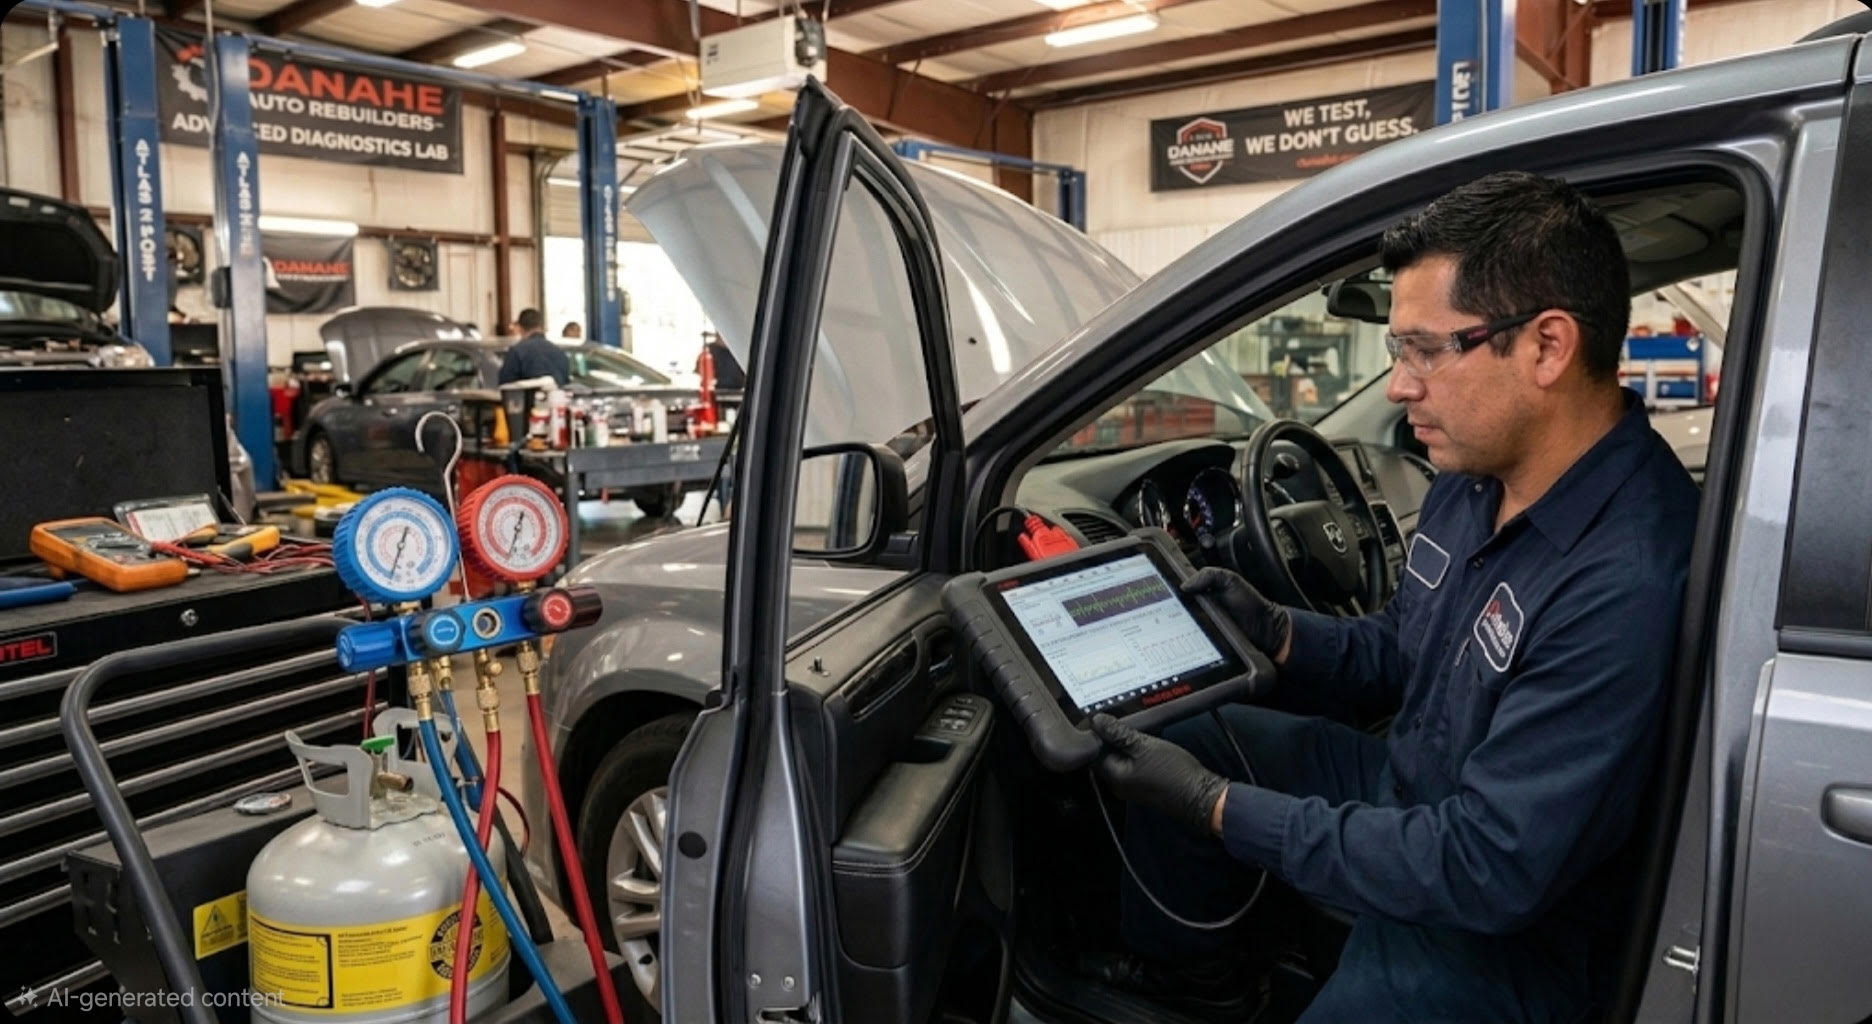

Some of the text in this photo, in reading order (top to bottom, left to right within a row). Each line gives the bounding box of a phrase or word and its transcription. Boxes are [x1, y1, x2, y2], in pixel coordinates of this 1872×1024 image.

[1284, 99, 1372, 127] WE TEST,
[290, 128, 412, 157] DIAGNOSTICS
[415, 142, 449, 160] LAB
[1245, 116, 1419, 155] WE DON'T GUESS.
[135, 138, 153, 204] ATLAS
[236, 151, 252, 210] ATLAS
